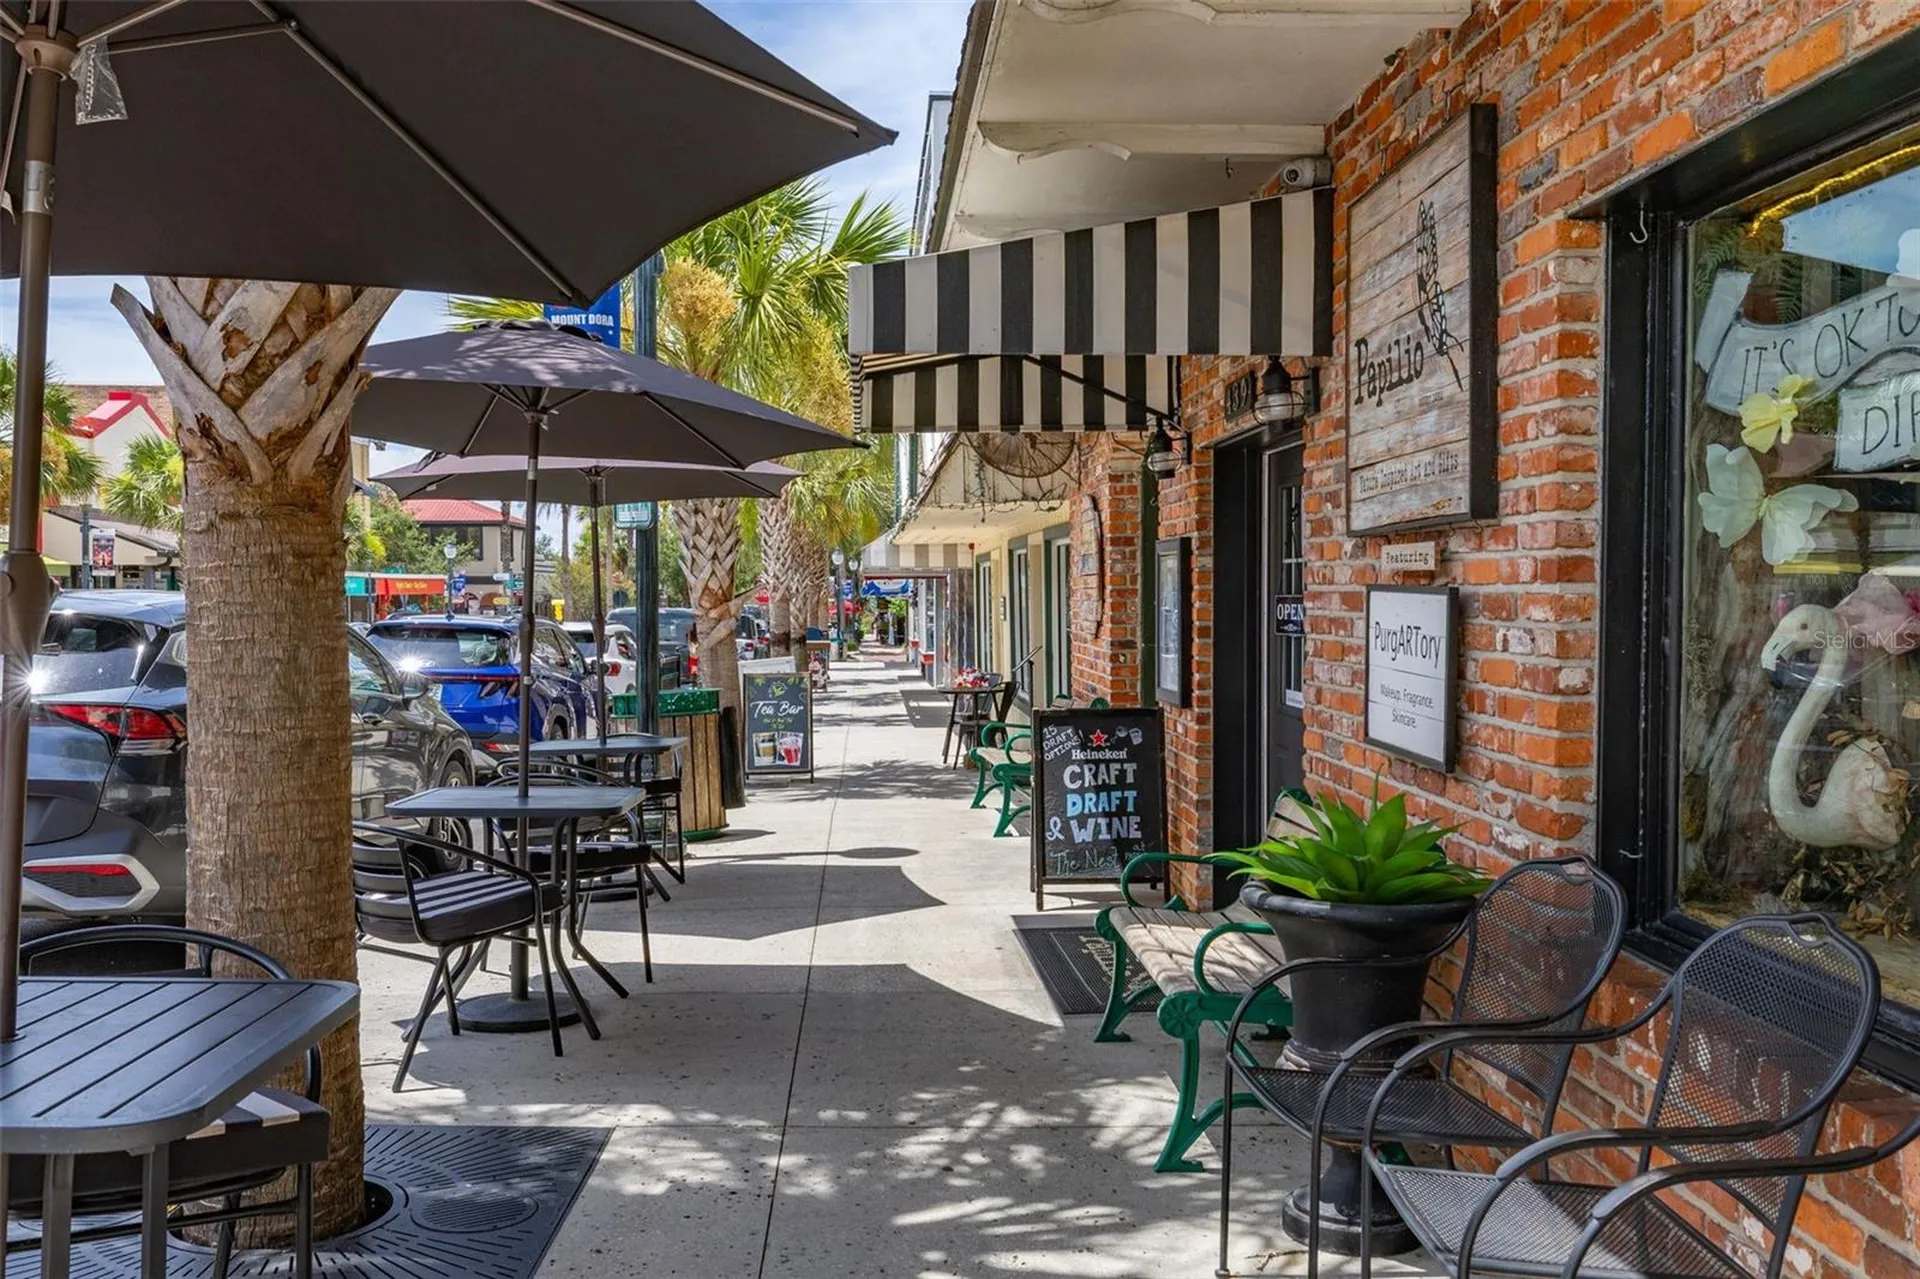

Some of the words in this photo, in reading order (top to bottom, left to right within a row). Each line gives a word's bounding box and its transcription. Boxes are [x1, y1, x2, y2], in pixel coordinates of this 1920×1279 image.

[551, 313, 587, 325] MOUNT
[588, 314, 614, 327] DORA
[1814, 307, 1868, 379] OK
[1354, 334, 1424, 407] Papilio
[1386, 551, 1429, 565] Featuring
[1277, 603, 1304, 620] OPEN
[1374, 620, 1441, 669] PurgARTory
[750, 700, 777, 718] Tea
[777, 700, 804, 716] Bar
[1043, 728, 1075, 750] DRAFT
[1071, 748, 1128, 760] Heineken
[1063, 762, 1137, 789] CRAFT
[1066, 790, 1137, 817] DRAFT
[1046, 816, 1064, 840] &
[1070, 816, 1142, 844] WINE
[1050, 849, 1080, 875] The
